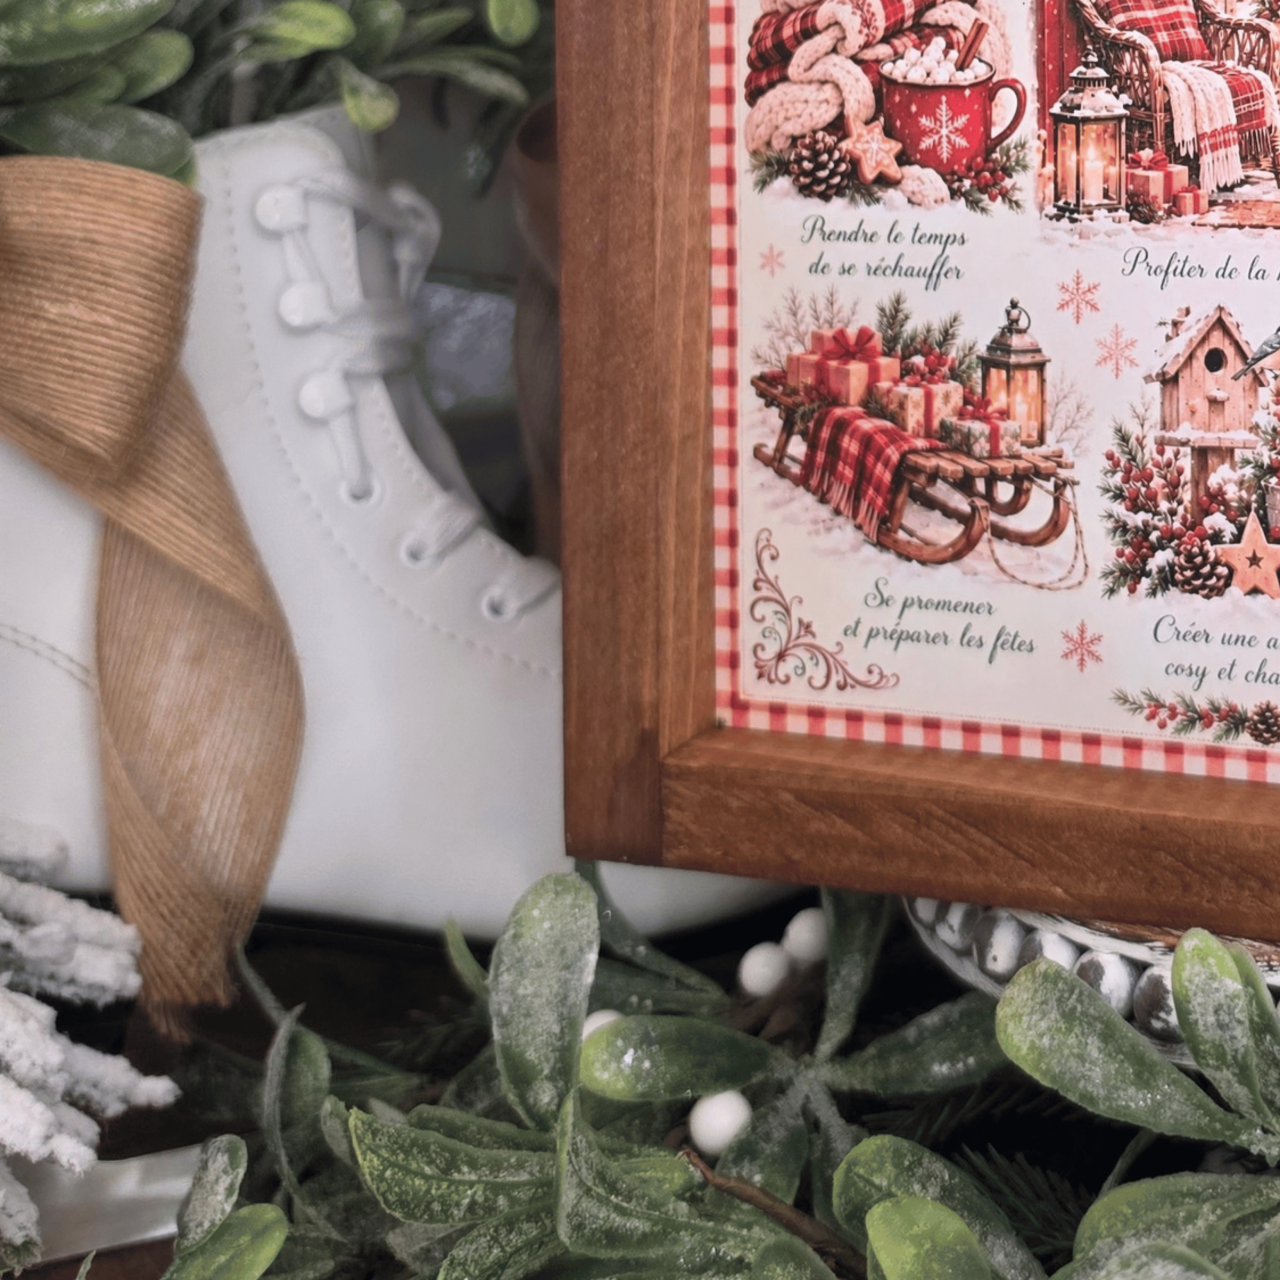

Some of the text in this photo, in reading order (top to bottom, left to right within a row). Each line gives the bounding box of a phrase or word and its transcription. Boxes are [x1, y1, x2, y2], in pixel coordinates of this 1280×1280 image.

[800, 214, 968, 256] Prendre le temps
[808, 251, 964, 292] de se réchauffer
[1121, 246, 1207, 291] Profiter
[1215, 255, 1240, 280] de
[1247, 255, 1270, 281] la
[864, 577, 995, 620] Se promener
[843, 617, 1036, 665] et préparer les fêtes
[1153, 614, 1214, 644] Créer
[1221, 632, 1259, 648] une
[1164, 660, 1210, 692] cosy
[1217, 659, 1238, 681] et
